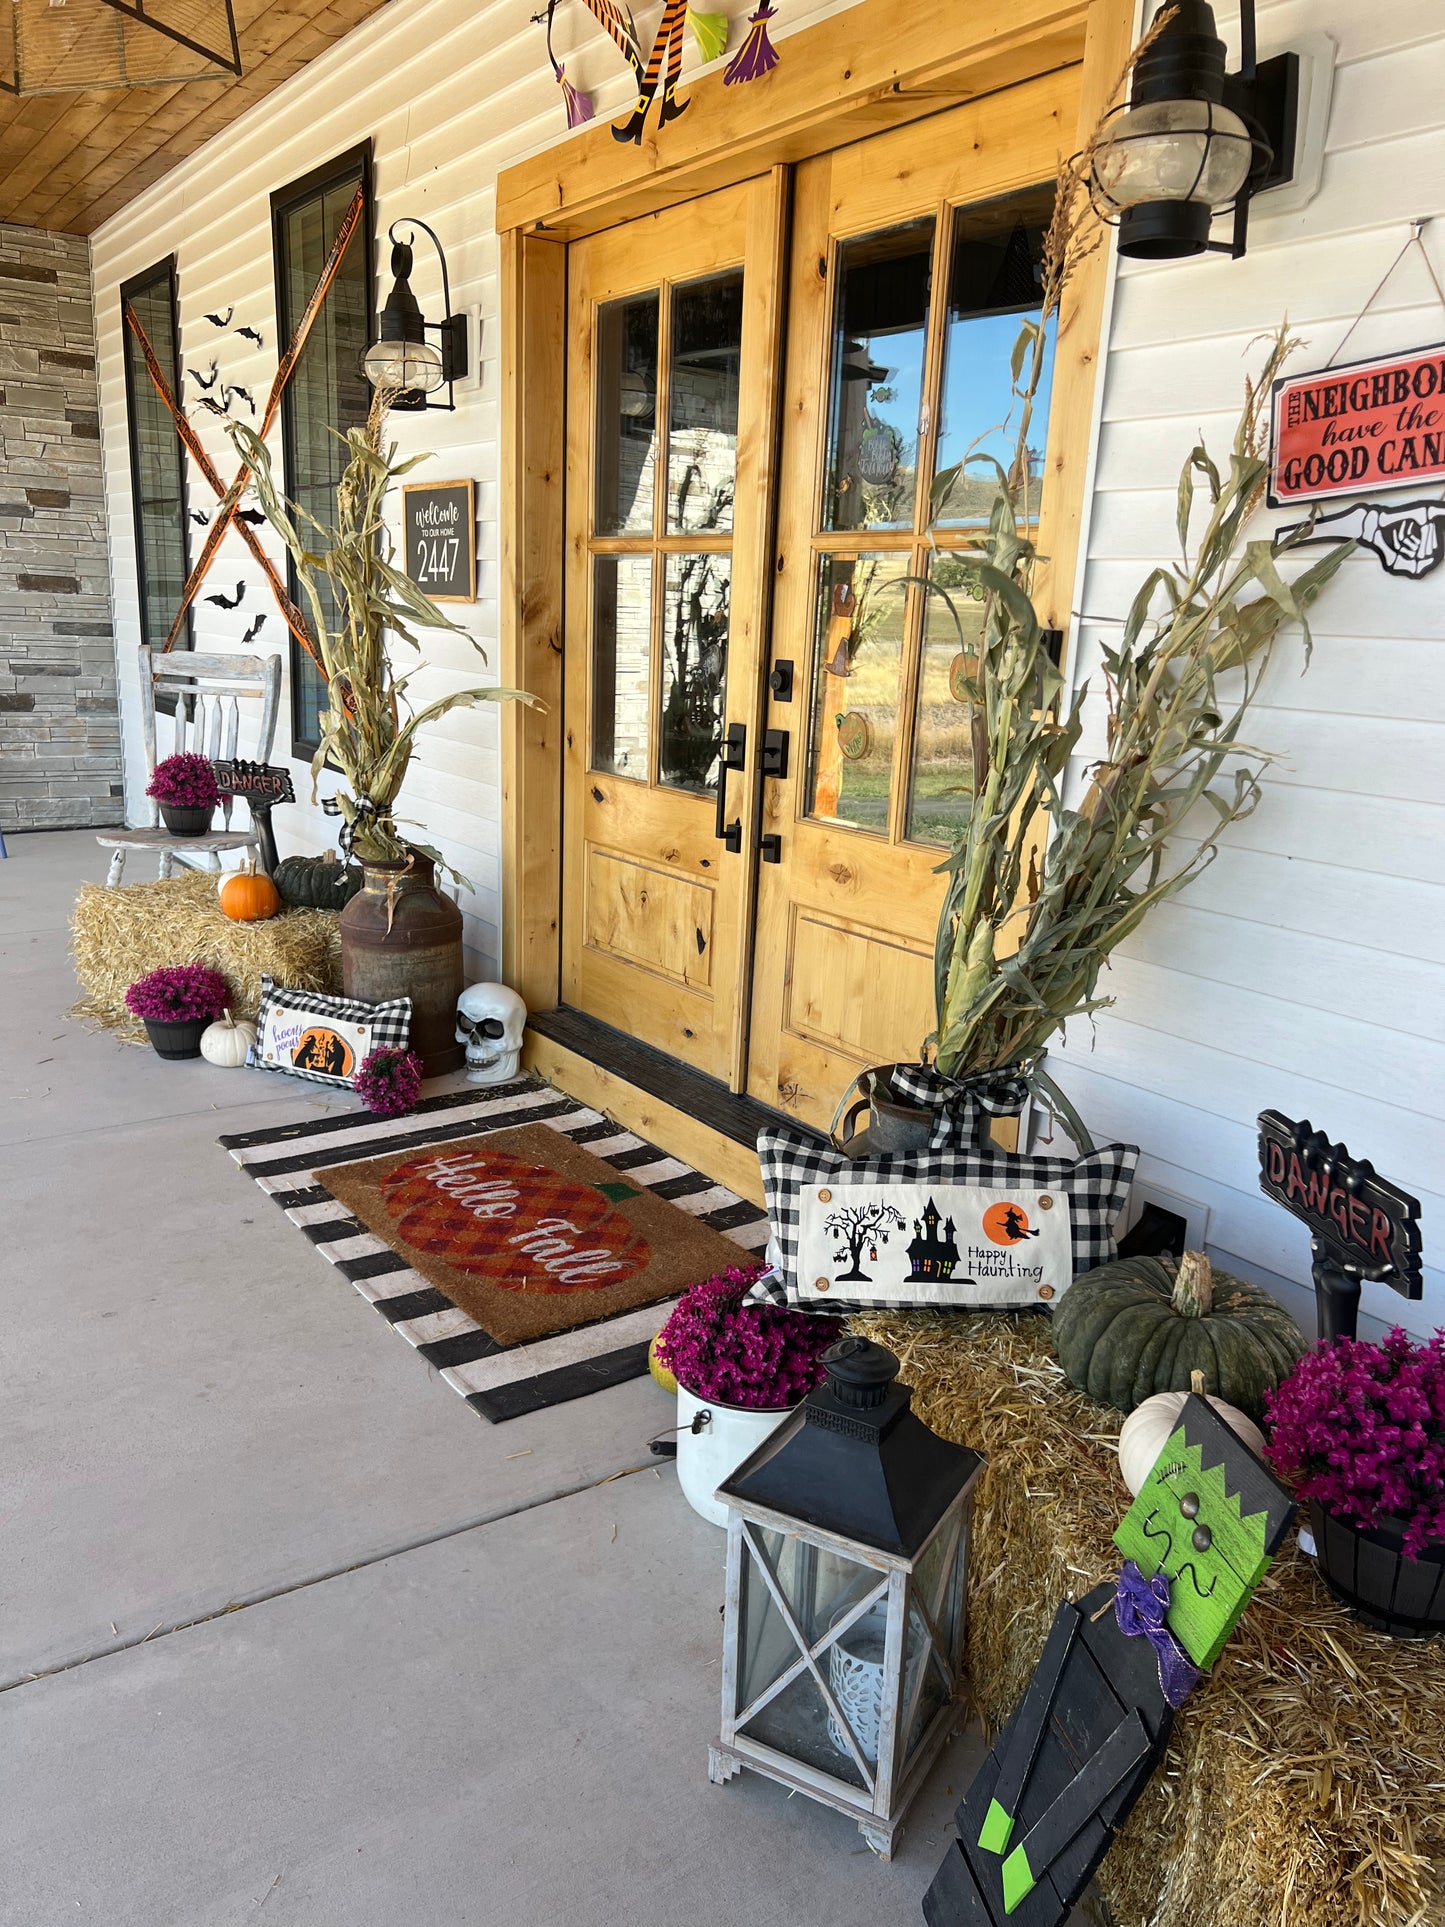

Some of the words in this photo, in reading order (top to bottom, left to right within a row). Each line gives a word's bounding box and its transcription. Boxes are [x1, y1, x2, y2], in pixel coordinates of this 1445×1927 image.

[1287, 391, 1301, 428] THE
[1321, 420, 1387, 447] have
[1393, 402, 1445, 432] the
[1284, 446, 1369, 490] GOOD
[1377, 431, 1445, 474] CAN
[421, 529, 428, 537] TO
[429, 528, 439, 537] OUR
[440, 527, 455, 536] HOME
[417, 538, 460, 582] 2447
[220, 771, 284, 794] DANGER
[273, 1024, 303, 1042] hocus
[276, 1037, 299, 1060] pocus
[414, 1153, 520, 1219] Hello
[1269, 1142, 1391, 1263] DANGER
[508, 1218, 622, 1284] Fall
[968, 1246, 1007, 1265] Happy
[968, 1254, 1043, 1283] Haunting
